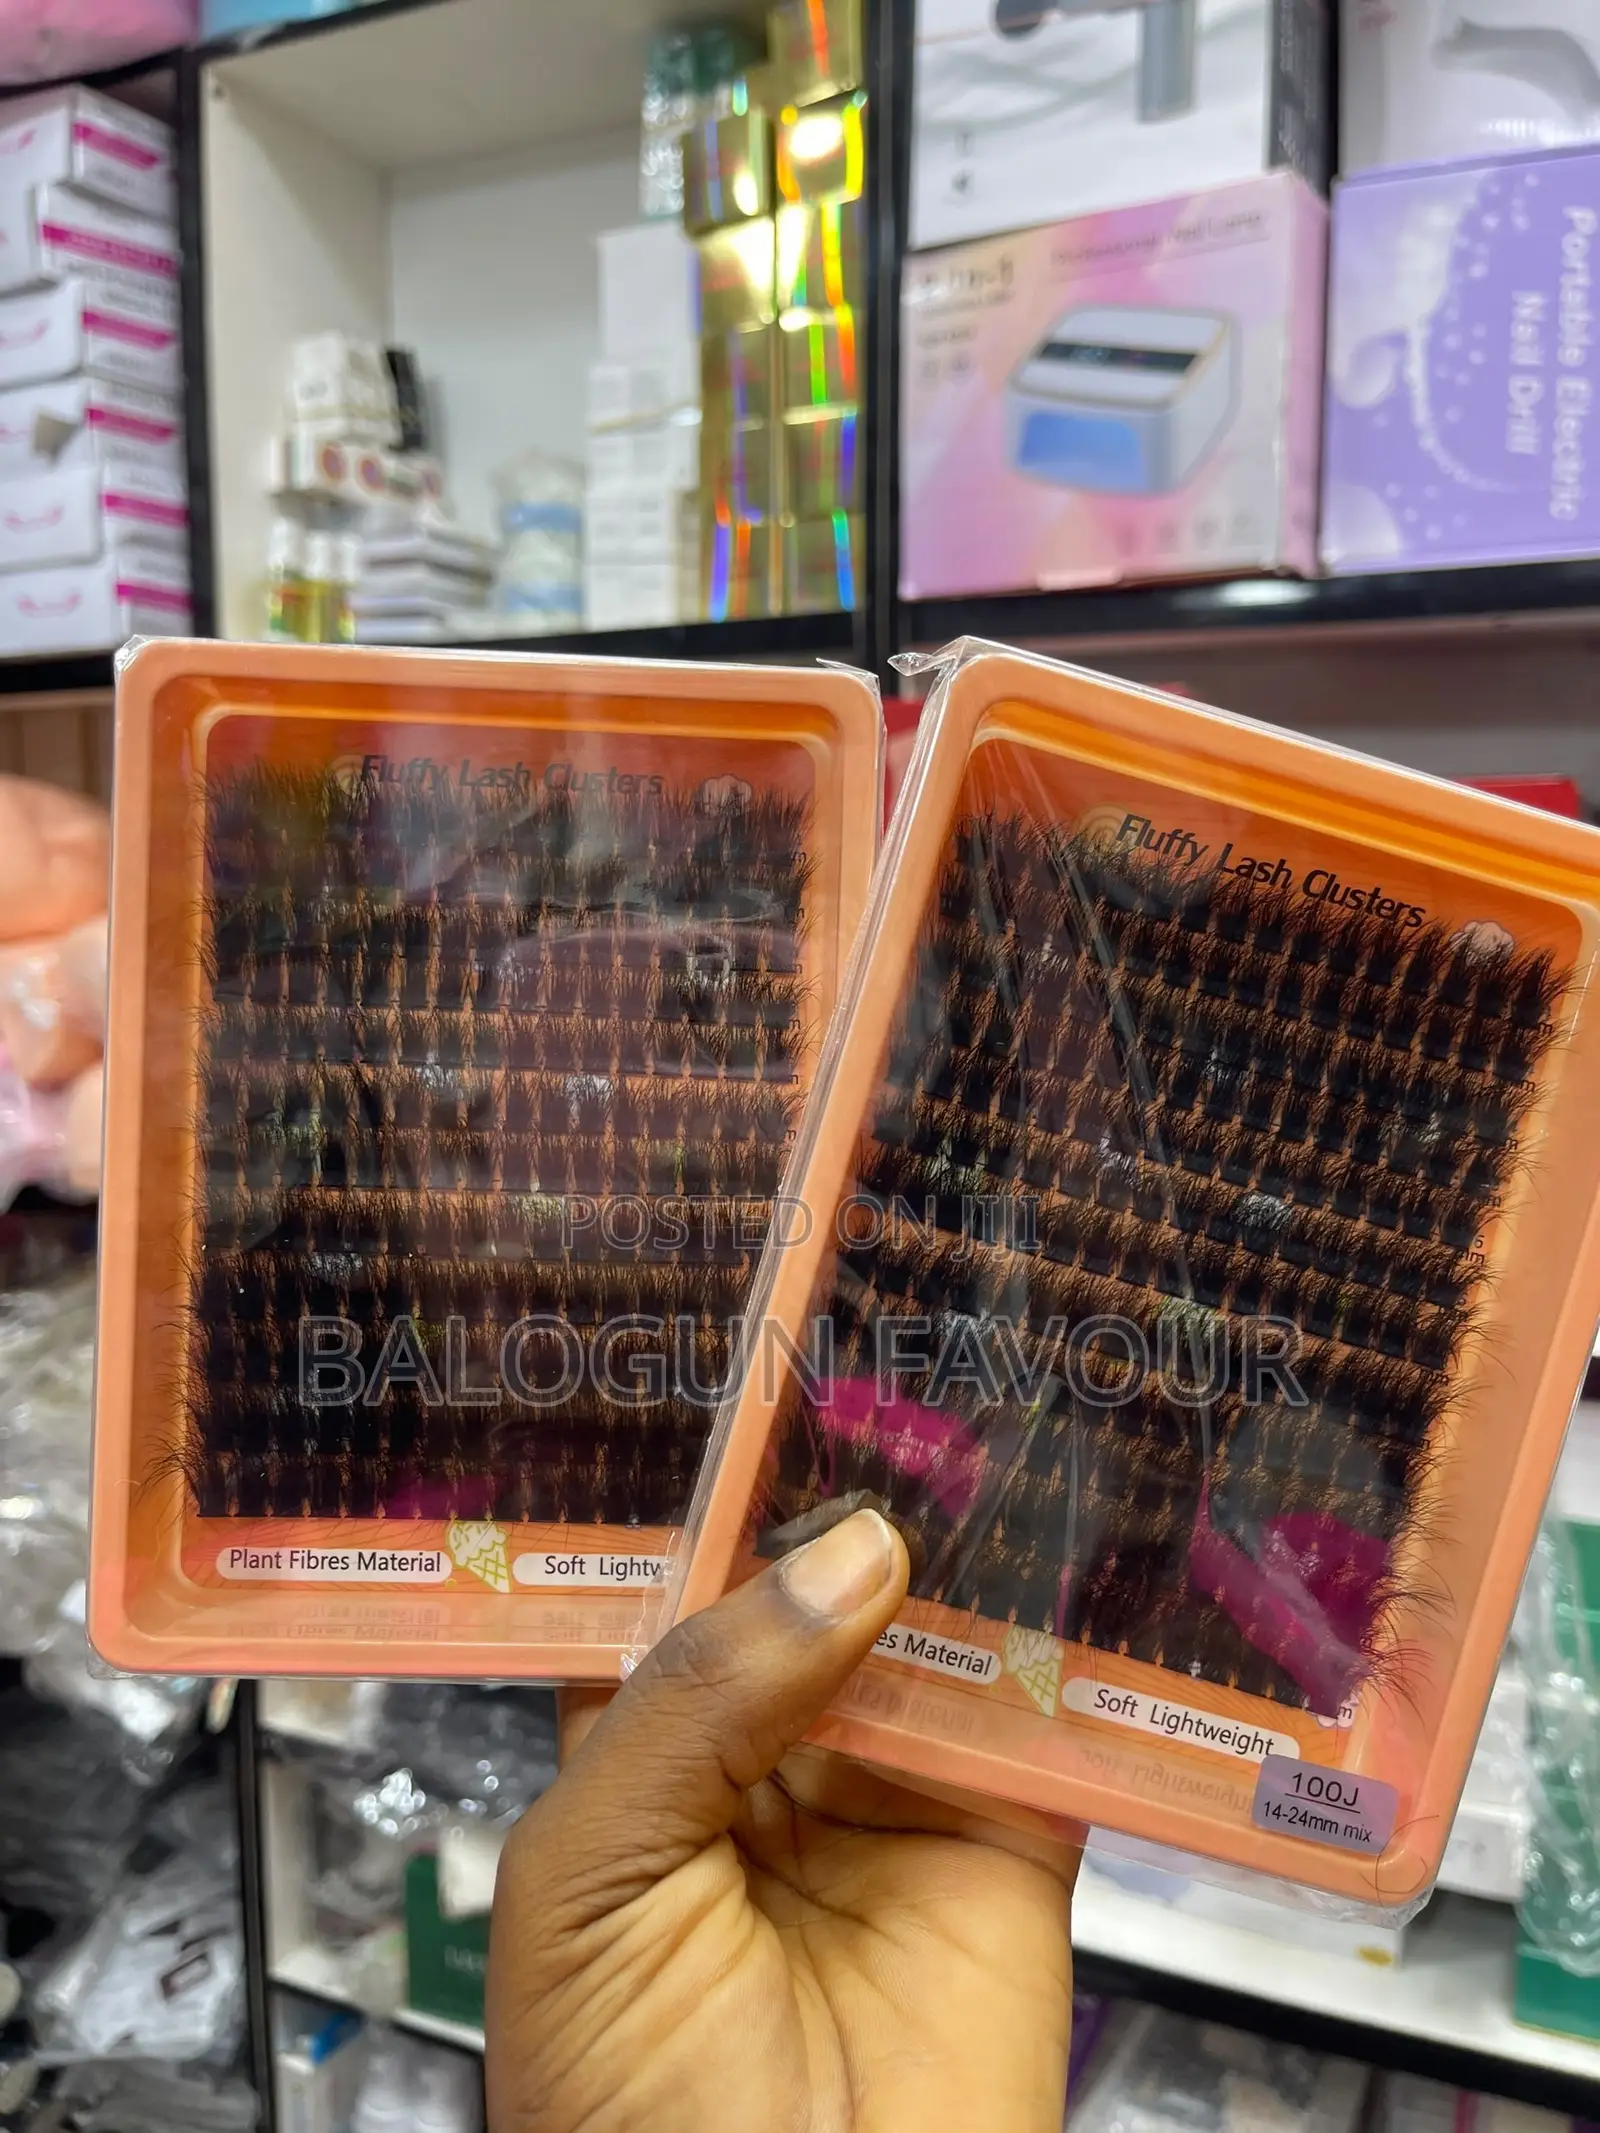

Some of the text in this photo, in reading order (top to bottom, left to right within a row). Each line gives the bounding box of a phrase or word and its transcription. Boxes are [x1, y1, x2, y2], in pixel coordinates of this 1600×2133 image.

[1506, 290, 1546, 454] Nail Drill
[1550, 206, 1597, 520] Portable Electric
[361, 754, 666, 795] Fluffy Lash Clusters
[1116, 813, 1427, 928] Fluffy Lash Clusters
[230, 1549, 441, 1573] Plant Fibres Material
[544, 1555, 662, 1582] Soft Lightw
[904, 1633, 993, 1676] Material
[1094, 1688, 1275, 1756] Soft Lightweight
[1292, 1772, 1359, 1807] 100J
[1263, 1801, 1373, 1843] 14-24mm mix
